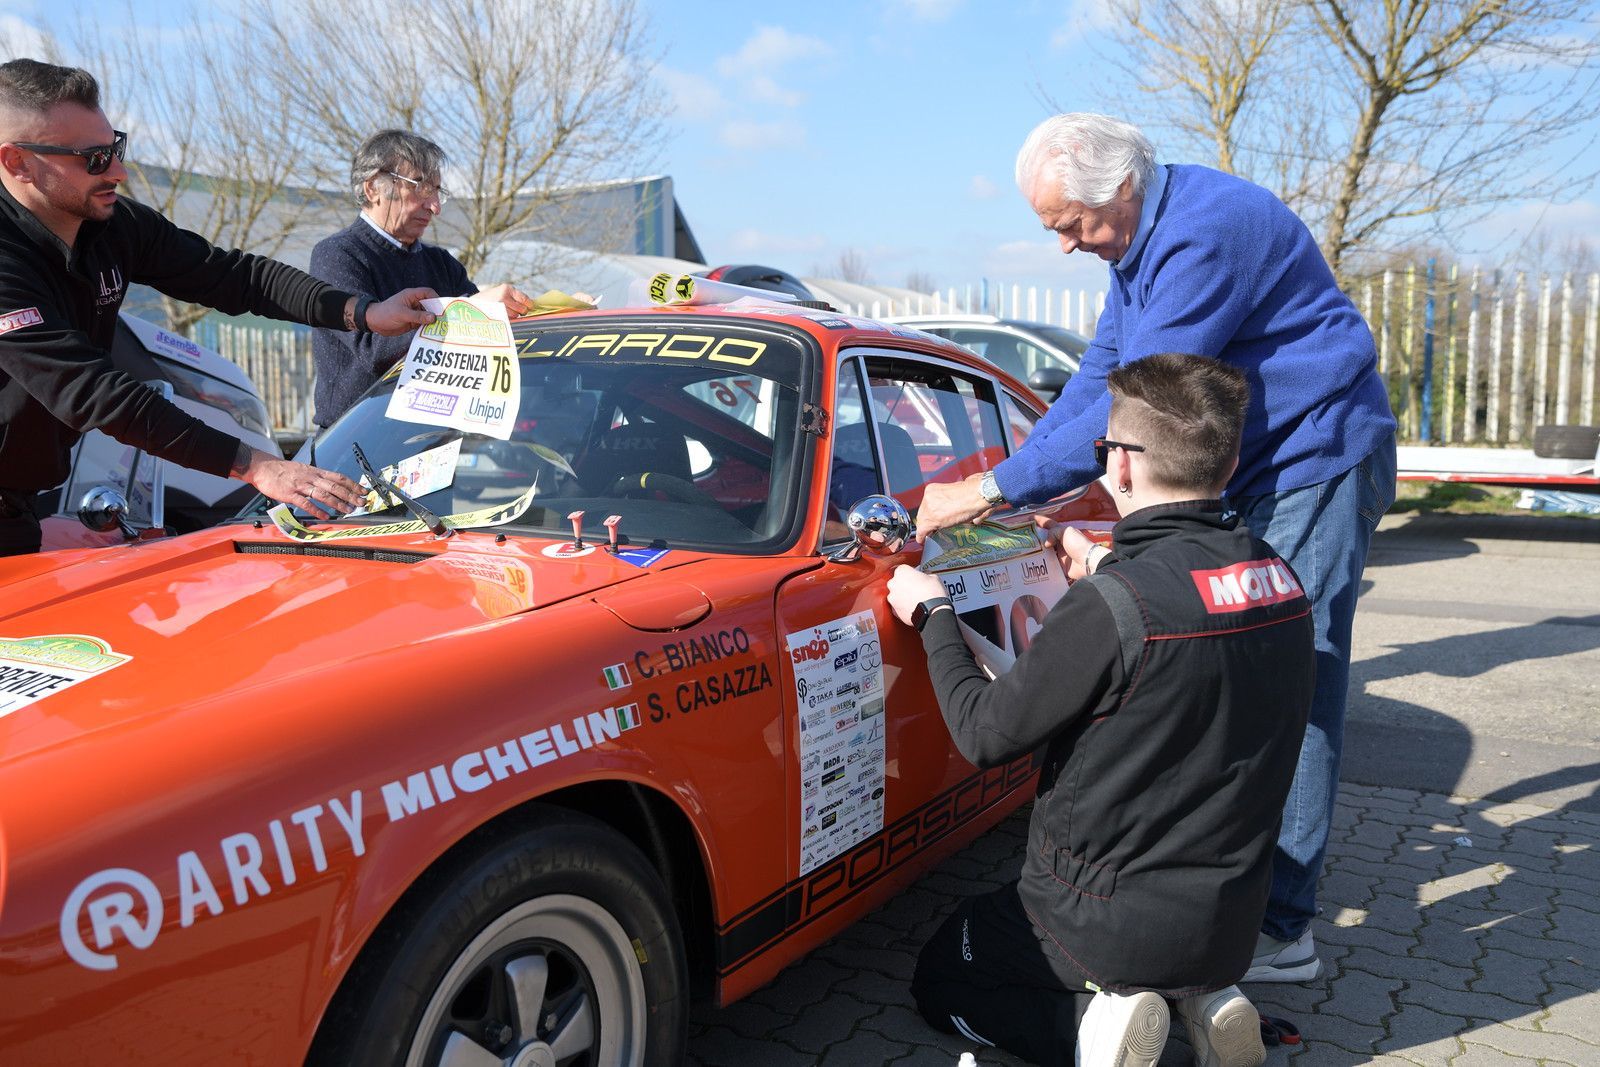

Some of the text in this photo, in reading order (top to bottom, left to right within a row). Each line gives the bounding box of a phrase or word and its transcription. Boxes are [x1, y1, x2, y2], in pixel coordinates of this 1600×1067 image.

[0, 309, 40, 331] OTUL
[412, 347, 511, 393] ASSISTENZA 76
[516, 333, 767, 366] LIARDO
[411, 368, 484, 390] SERVICE
[468, 396, 506, 424] Unipol
[944, 576, 967, 602] ipol
[980, 566, 1011, 591] Unipol
[1021, 559, 1049, 582] Unipol
[634, 627, 749, 679] C. BIANCO
[0, 665, 76, 698] RENTE
[647, 662, 773, 723] S. CASAZZA
[380, 707, 620, 822] MICHELIN
[804, 753, 1035, 917] PORSCHE
